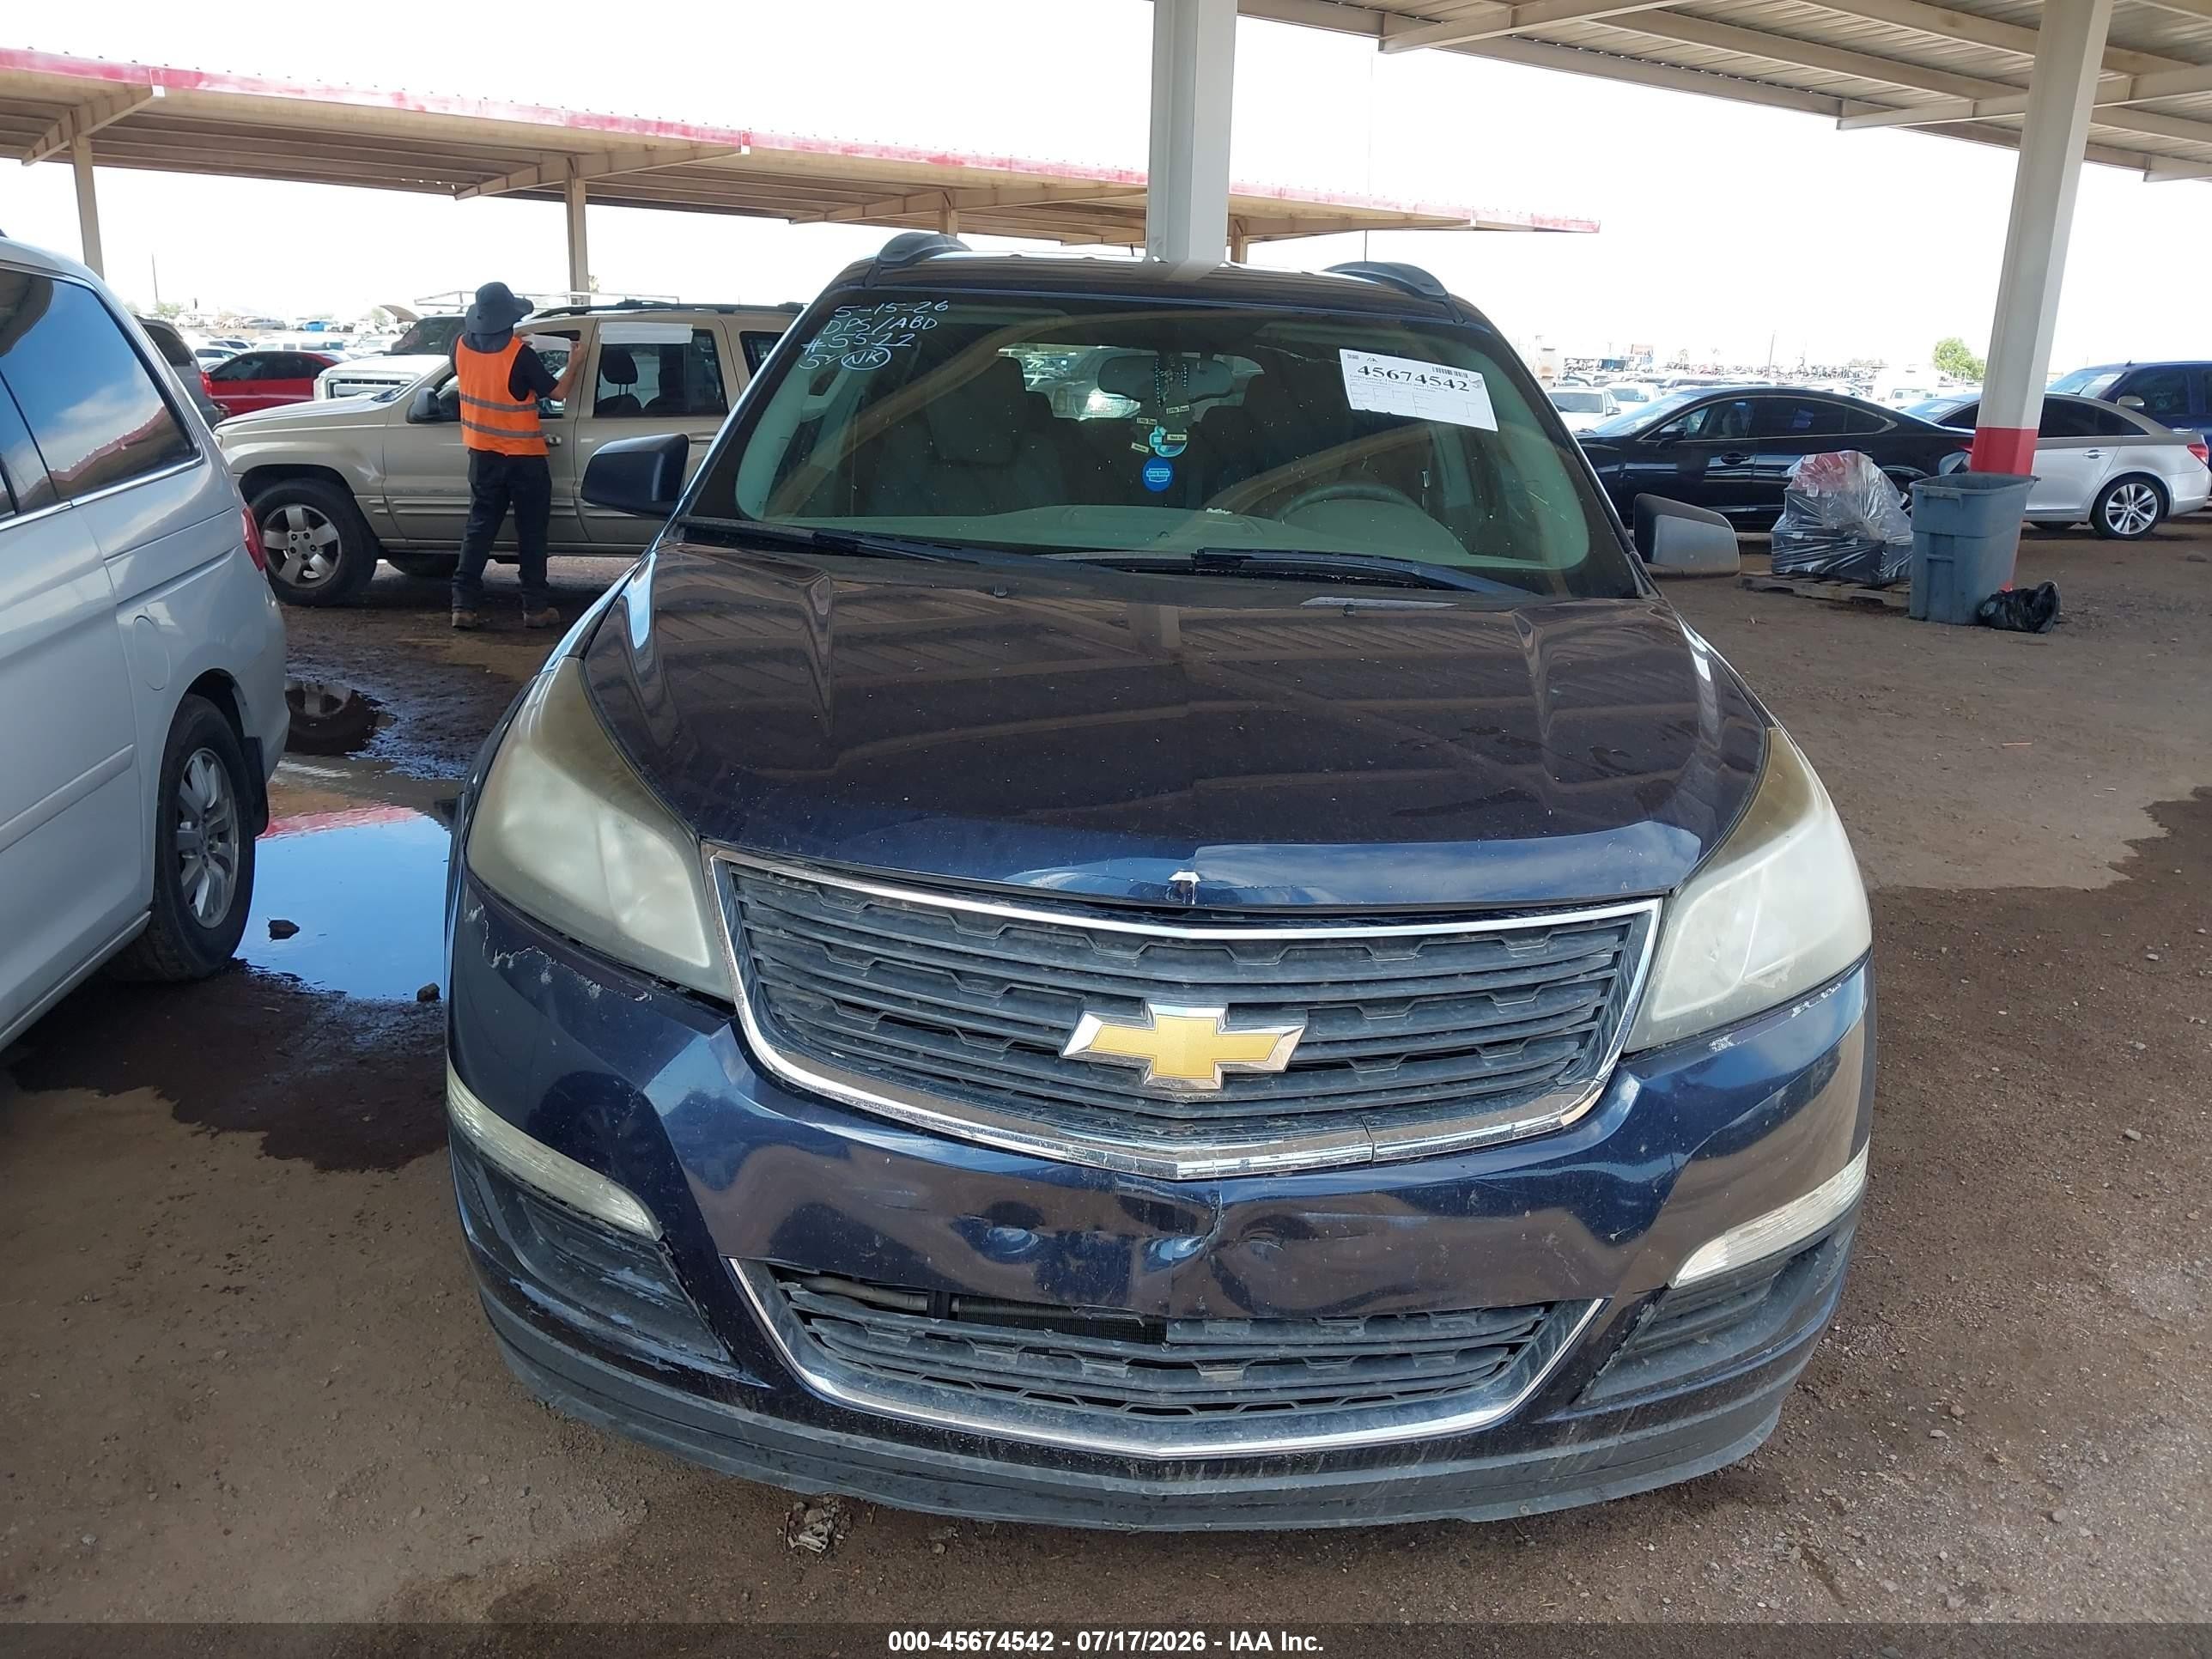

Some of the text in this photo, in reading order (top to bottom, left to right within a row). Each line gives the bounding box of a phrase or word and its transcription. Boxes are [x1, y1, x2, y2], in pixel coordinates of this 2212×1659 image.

[835, 301, 949, 318] 5-15-26
[823, 316, 939, 334] DPS/ABD
[1358, 365, 1469, 392] 45674542
